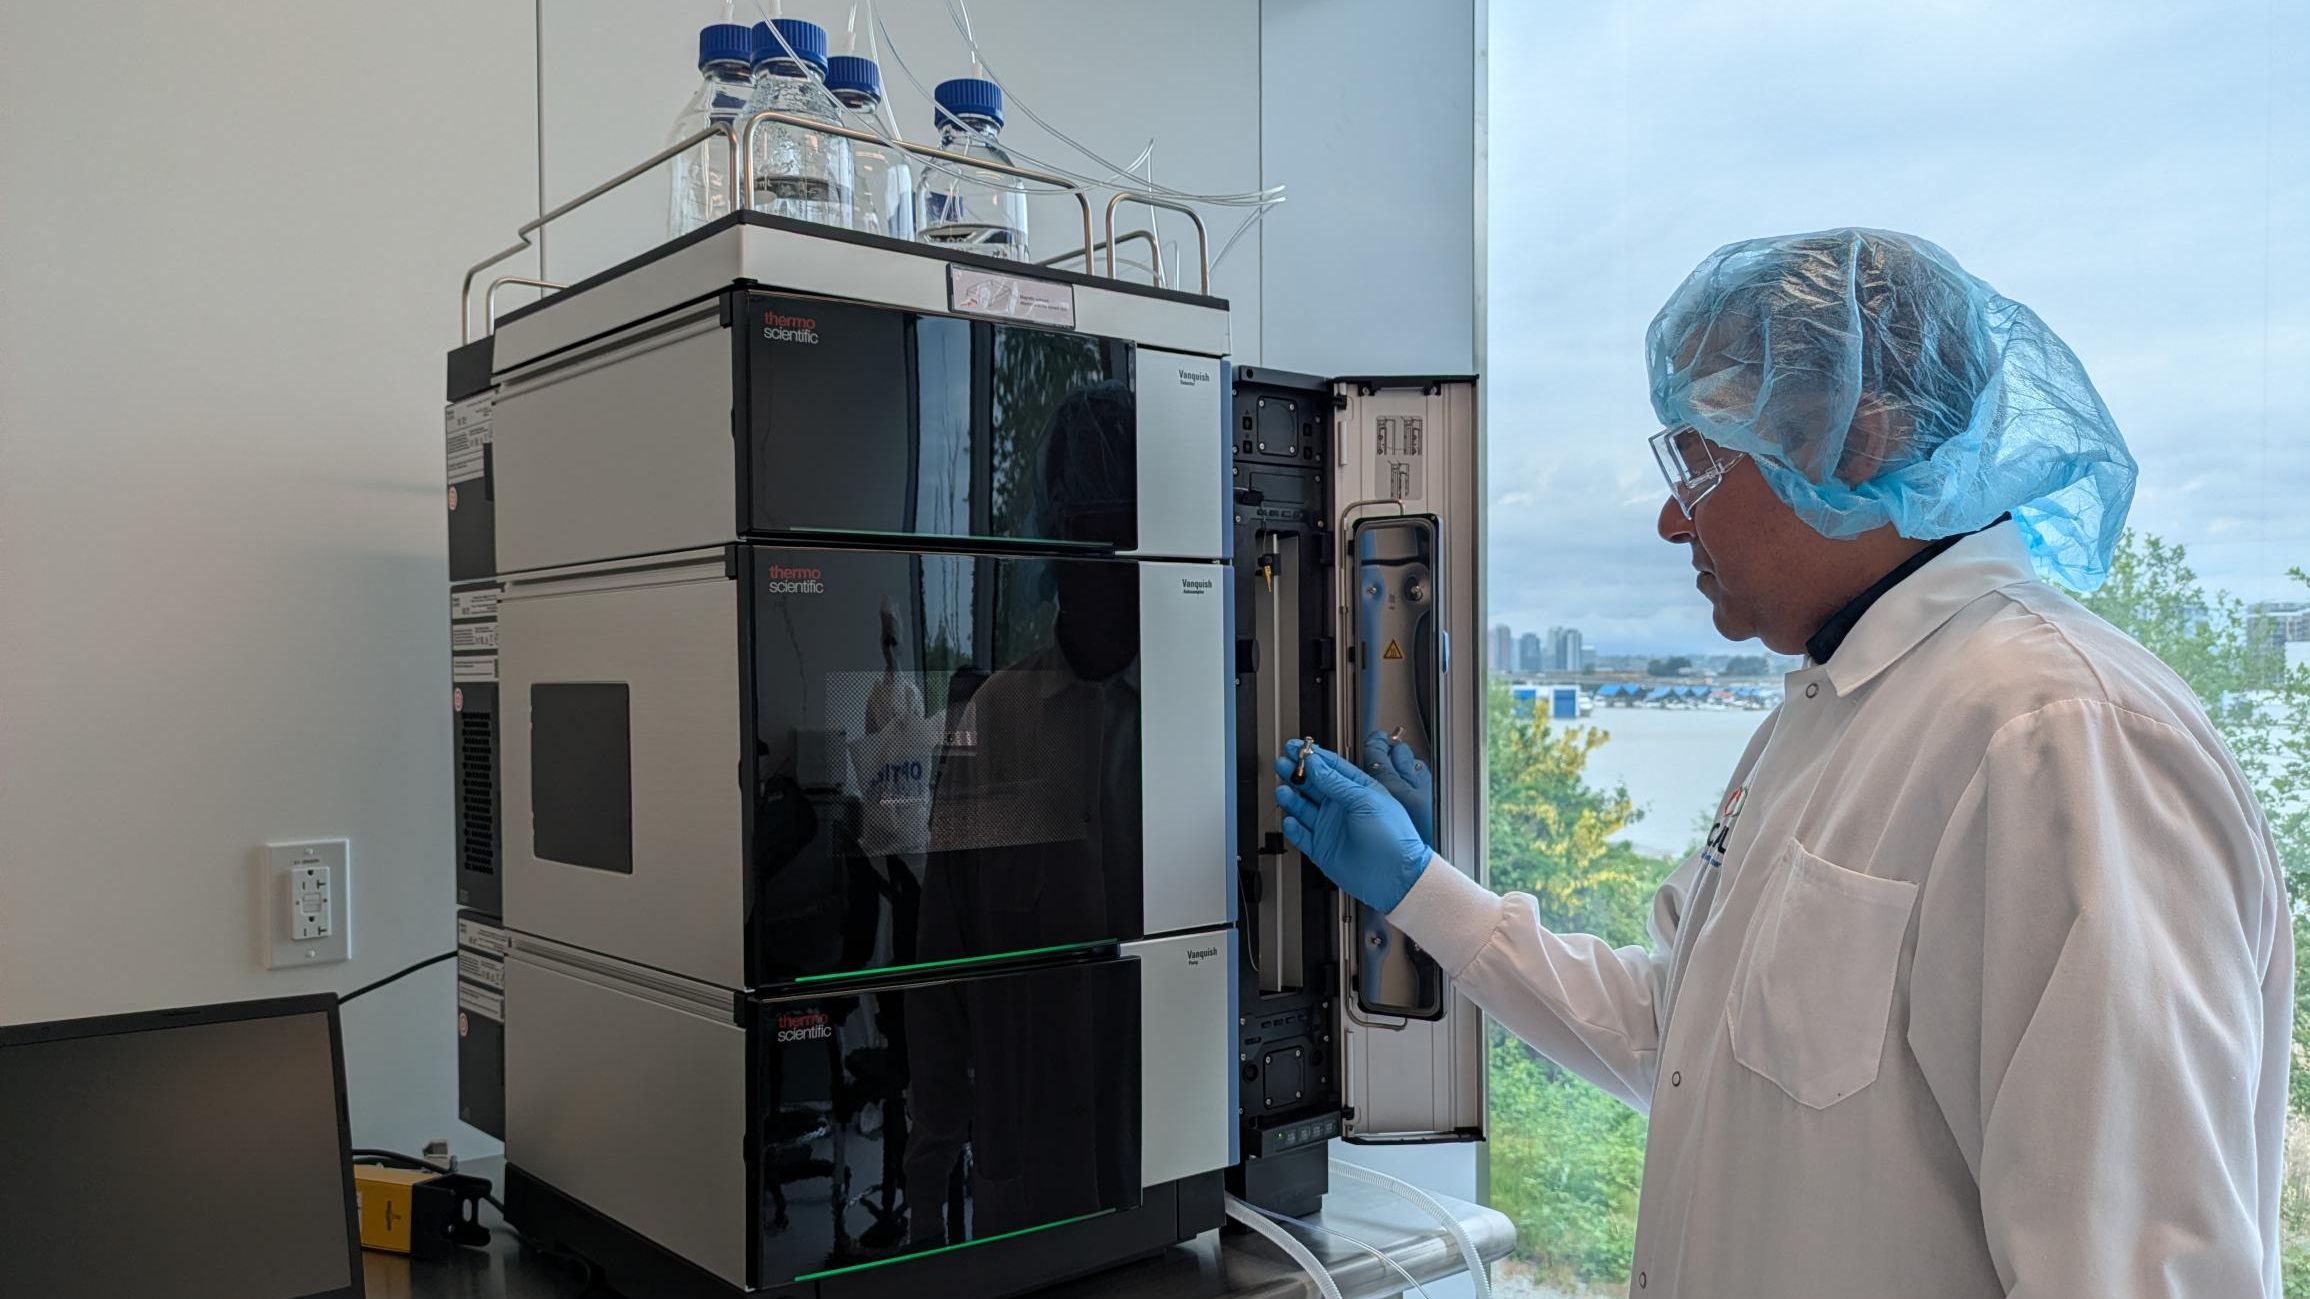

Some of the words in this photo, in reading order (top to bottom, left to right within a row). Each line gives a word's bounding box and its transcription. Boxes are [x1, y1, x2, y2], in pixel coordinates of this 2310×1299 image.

[764, 309, 816, 329] thermo
[764, 326, 819, 344] scientific
[1179, 369, 1210, 382] Vanquish
[769, 564, 821, 579] thermo
[769, 579, 824, 594] scientific
[1182, 579, 1212, 590] Vanquish
[1187, 947, 1217, 960] Vanquish
[779, 1013, 828, 1028] thermo
[778, 1024, 832, 1042] scientific
